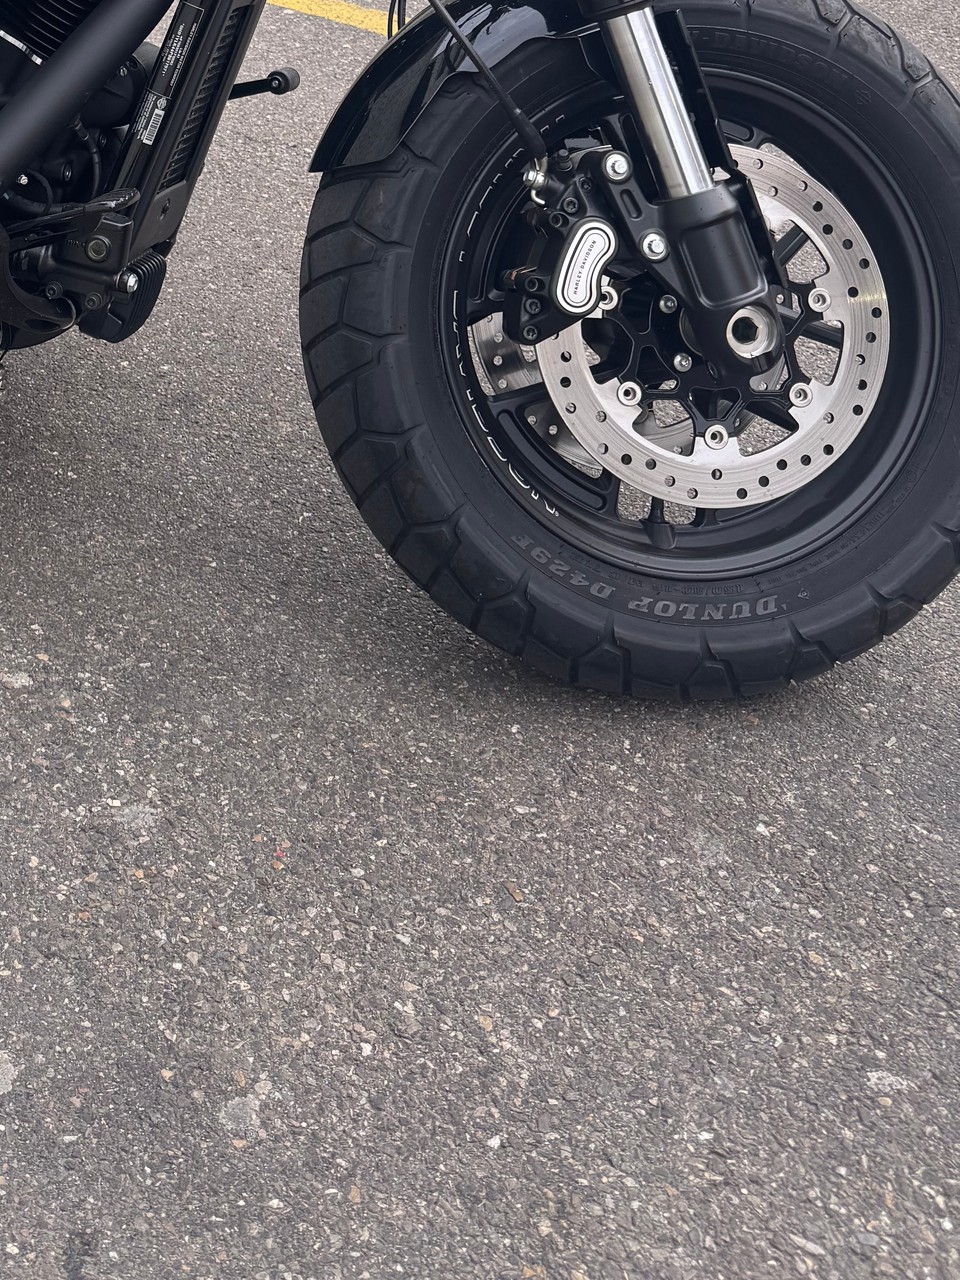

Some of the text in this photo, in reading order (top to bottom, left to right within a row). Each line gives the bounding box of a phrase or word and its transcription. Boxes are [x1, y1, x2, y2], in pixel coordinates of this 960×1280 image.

[573, 240, 597, 295] HARLEY-DAVIDSON
[510, 534, 778, 620] DUNLOP D429F
